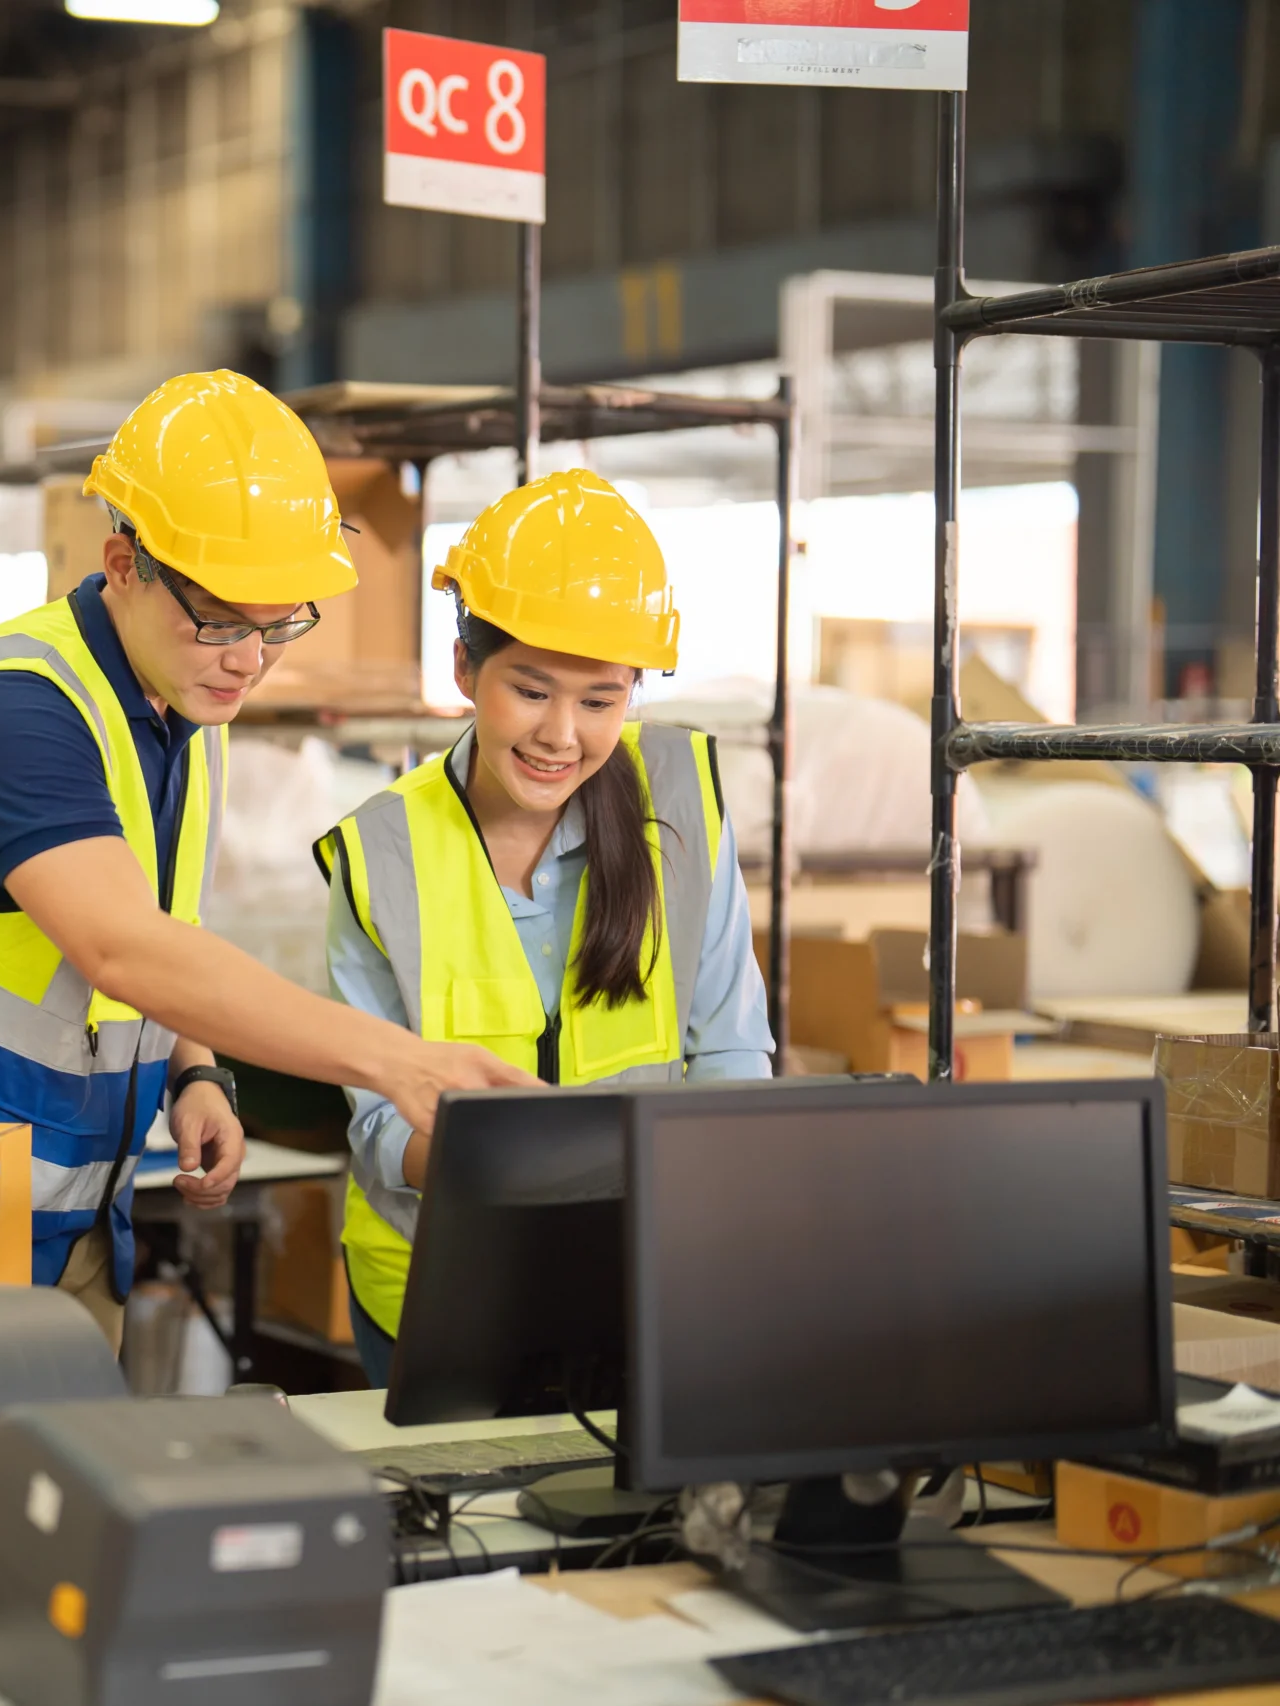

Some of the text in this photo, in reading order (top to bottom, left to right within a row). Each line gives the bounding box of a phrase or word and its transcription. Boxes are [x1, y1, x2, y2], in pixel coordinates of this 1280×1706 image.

[785, 65, 861, 75] FULFILLMENT
[398, 58, 526, 155] QC 8
